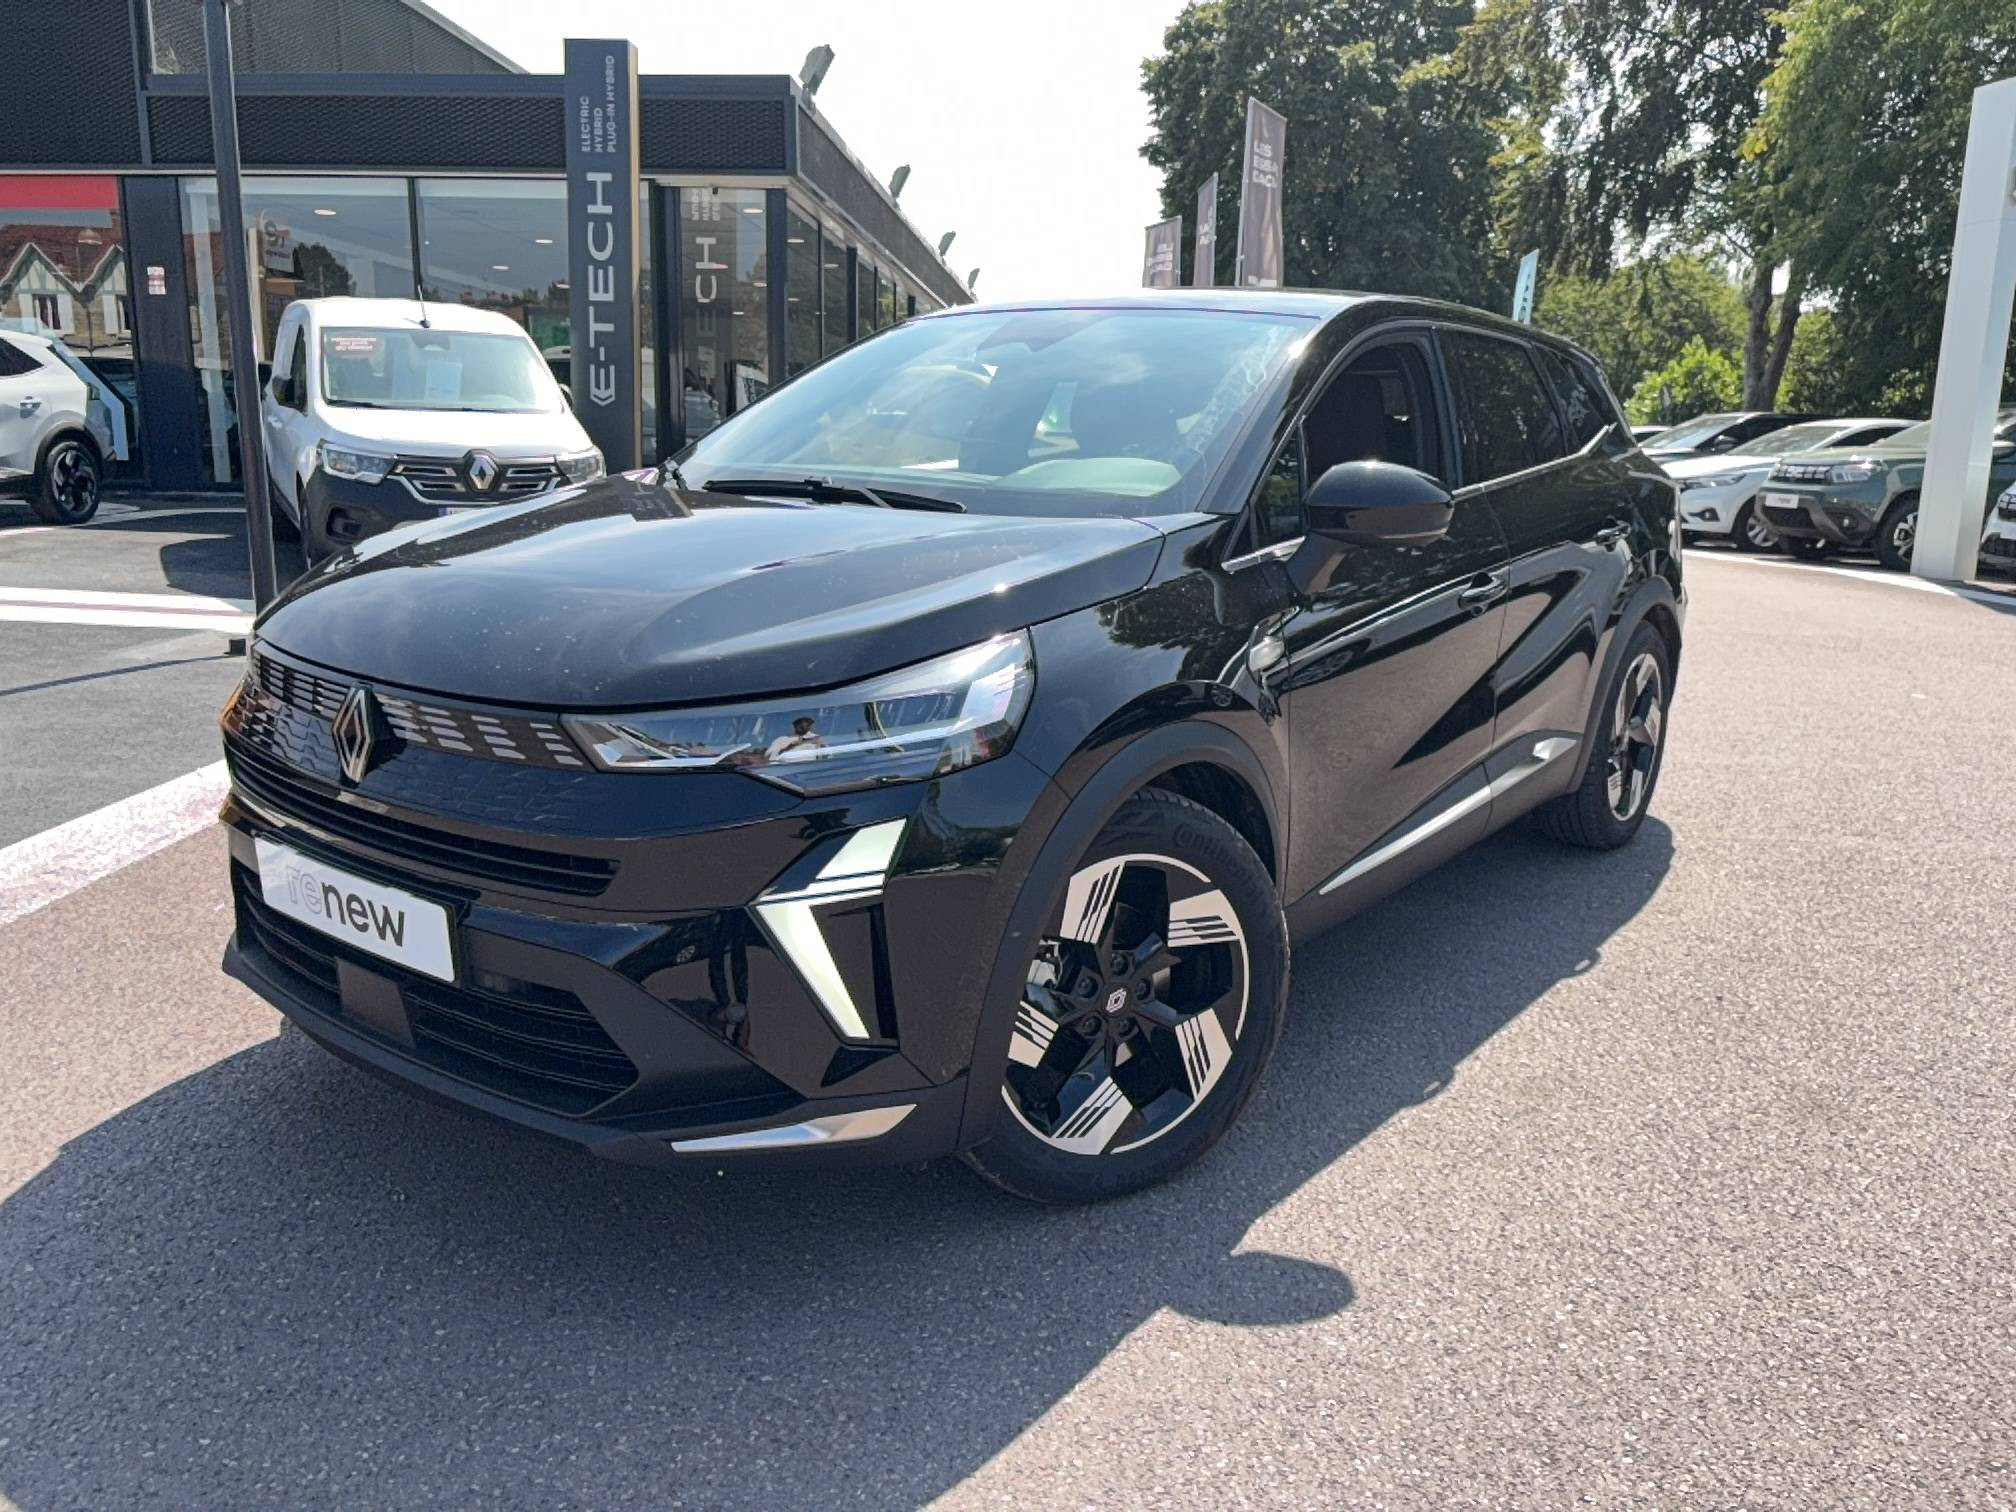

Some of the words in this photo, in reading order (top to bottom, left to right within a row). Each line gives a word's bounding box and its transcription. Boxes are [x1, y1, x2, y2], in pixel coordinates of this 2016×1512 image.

[605, 55, 615, 101] HYBRID
[580, 96, 591, 152] ELECTRIC
[593, 107, 603, 152] HYBRID
[606, 103, 617, 153] PLUG-IN
[586, 172, 615, 407] E-TECH
[286, 865, 405, 948] renew
